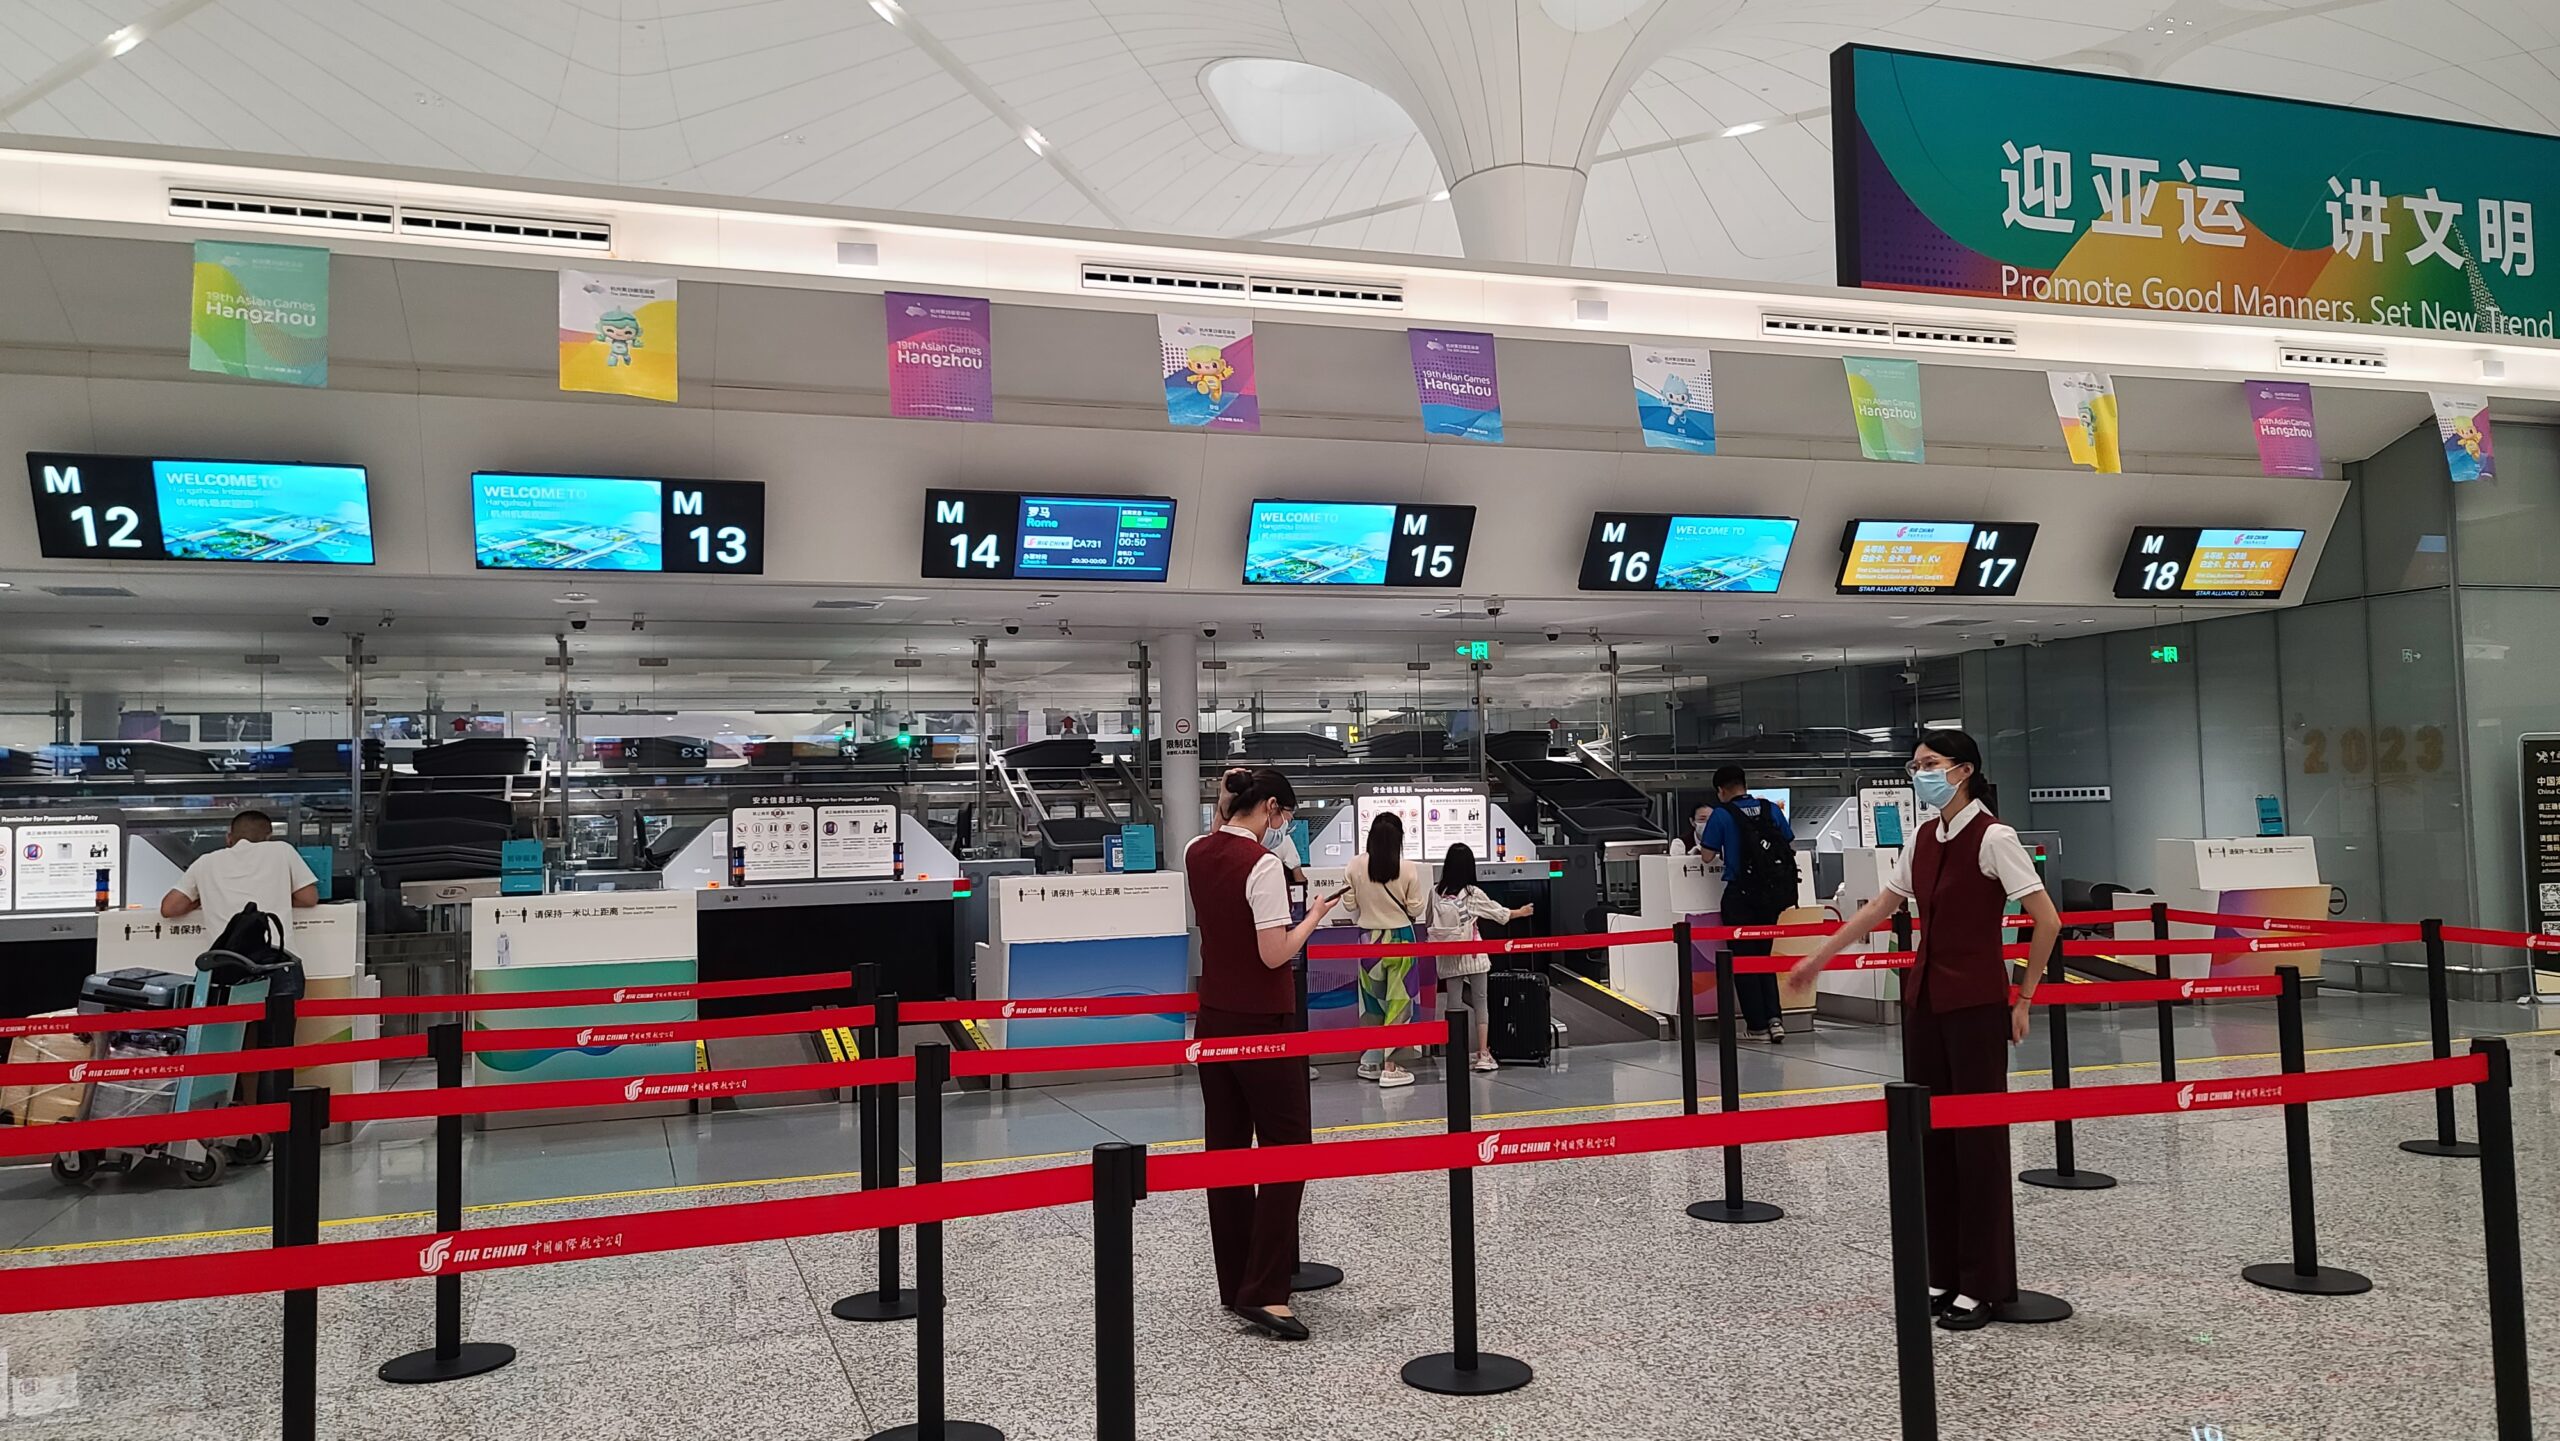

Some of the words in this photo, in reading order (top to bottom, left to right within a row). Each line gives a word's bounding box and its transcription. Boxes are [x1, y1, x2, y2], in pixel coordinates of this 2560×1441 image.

[2001, 139, 2247, 248] 迎亚运
[2325, 175, 2535, 277] 讲文明
[236, 295, 272, 308] Asian
[273, 298, 316, 312] Games
[2001, 264, 2132, 306] Promote
[2142, 277, 2222, 313] Good
[2370, 296, 2413, 330] Set
[2421, 301, 2479, 334] New
[2485, 304, 2554, 339] Trend
[205, 301, 317, 327] Hangzhou
[896, 341, 919, 350] 19th
[920, 341, 948, 353] Asian
[948, 344, 982, 356] Games
[897, 350, 983, 370] Hangzhou
[1422, 370, 1441, 379] 19th
[1442, 372, 1463, 382] Asian
[1463, 374, 1491, 385] Games
[1424, 378, 1492, 397] Hangzhou
[1858, 404, 1917, 419] Hangzhou
[2260, 425, 2313, 439] Hangzhou
[43, 465, 82, 495] M
[166, 472, 258, 488] WELCOME
[484, 485, 566, 500] WELCOME
[672, 490, 703, 515] M
[936, 500, 965, 524] M
[1027, 506, 1051, 519] 罗马
[1260, 511, 1322, 524] WELCOME
[70, 505, 143, 548] 12
[1026, 518, 1059, 529] Rome
[1402, 513, 1428, 536] M
[1675, 525, 1729, 536] WELCOME
[1601, 522, 1627, 543] M
[1974, 530, 1999, 551] M
[689, 526, 748, 565] 13
[1073, 539, 1102, 549] CA731
[1118, 538, 1147, 547] 00:50
[2140, 534, 2165, 555] M
[949, 533, 1001, 569] 14
[1116, 556, 1136, 566] 470
[1410, 544, 1455, 578] 15
[1607, 551, 1651, 583] 16
[1978, 558, 2018, 589] 17
[2142, 560, 2180, 591] 18
[2302, 725, 2444, 774] 2023
[1372, 786, 1413, 794] 安全信息提示
[752, 795, 803, 805] 安全信息提示
[1051, 887, 1121, 898] 请保持一米以上距离
[534, 907, 619, 919] 请保持一米以上距离
[592, 1034, 605, 1042] AIR
[606, 1033, 628, 1041] CHINA
[1201, 1049, 1215, 1057] AIR
[1216, 1047, 1238, 1056] CHINA
[88, 1069, 103, 1077] AIR
[104, 1068, 130, 1076] CHINA
[644, 1086, 661, 1095] AIR
[661, 1084, 689, 1094] CHINA
[1500, 1143, 1519, 1155] AIR
[1520, 1141, 1551, 1154] CHINA
[453, 1249, 478, 1263] AIR
[482, 1243, 528, 1260] CHINA
